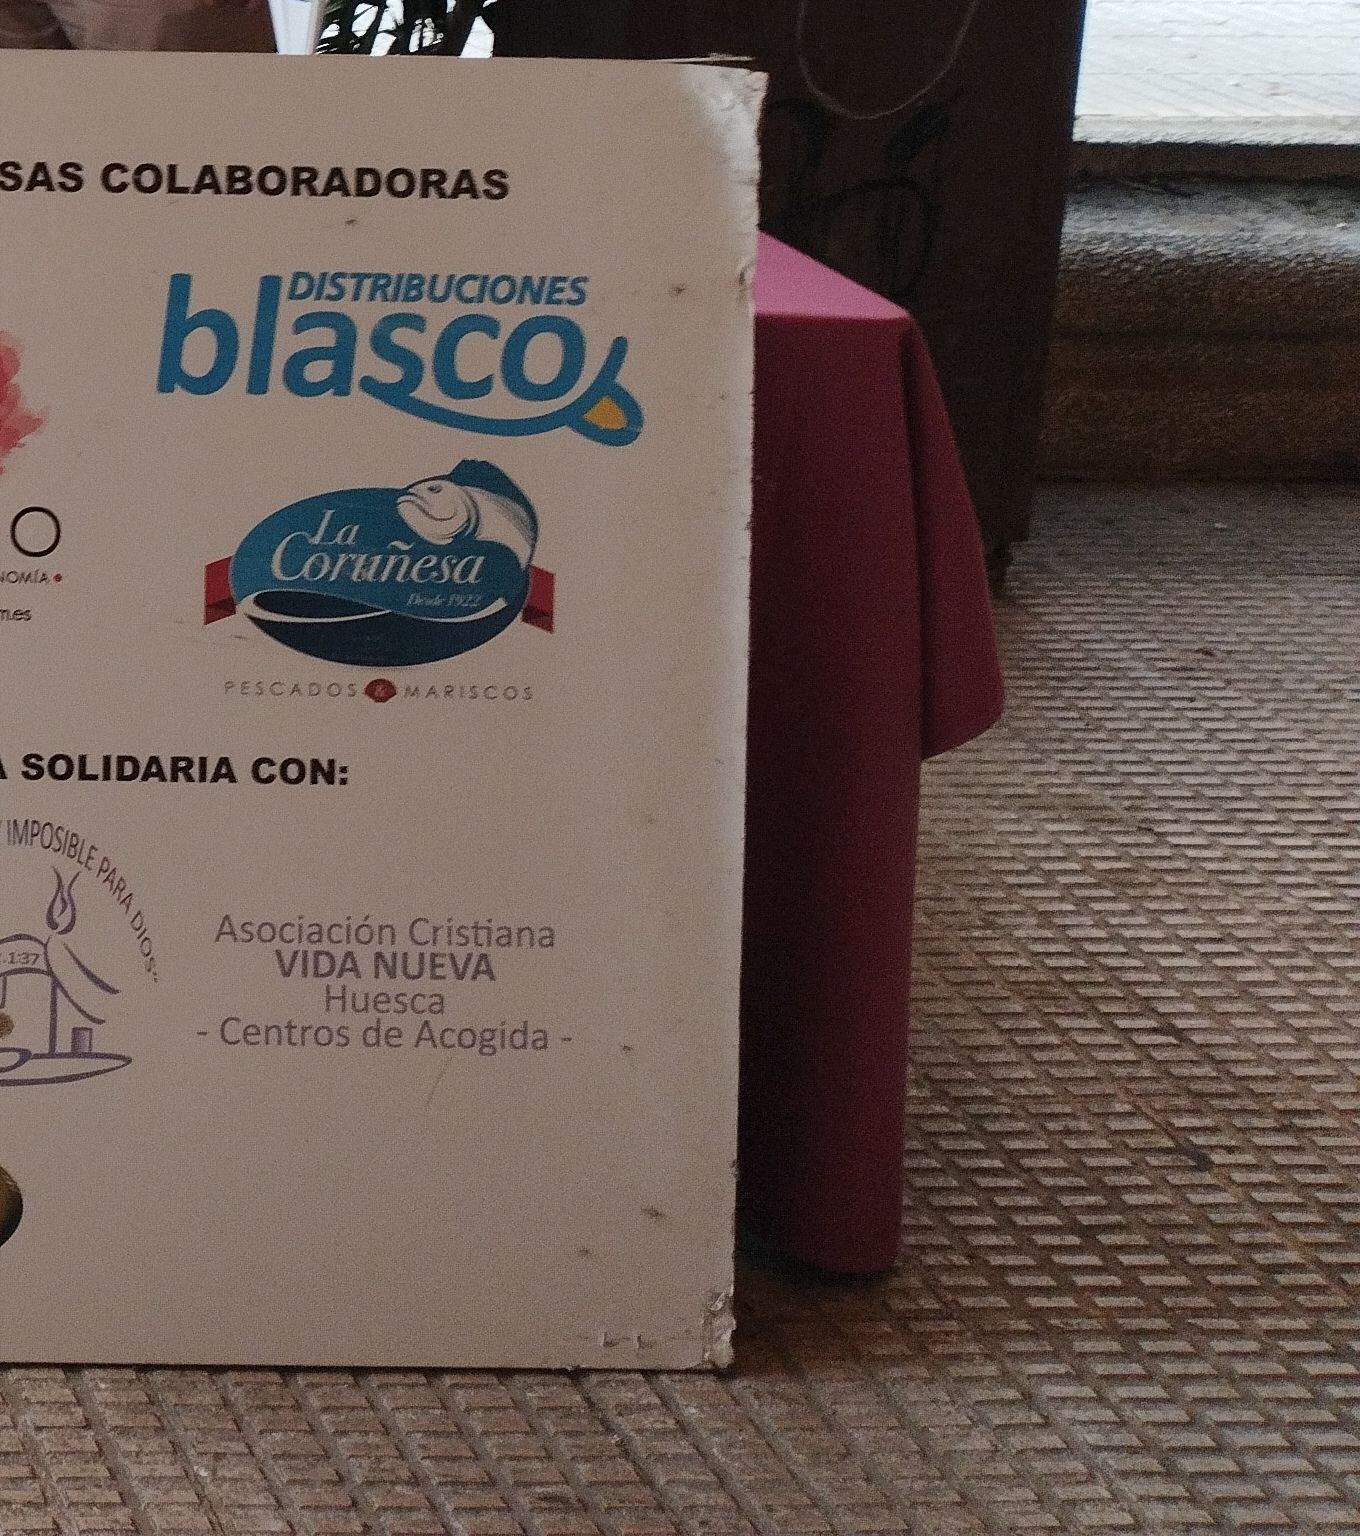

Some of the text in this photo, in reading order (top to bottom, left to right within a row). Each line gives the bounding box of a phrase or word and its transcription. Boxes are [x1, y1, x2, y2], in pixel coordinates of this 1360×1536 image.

[100, 161, 511, 201] COLABORADORAS
[287, 270, 589, 307] DISTRIBUCIONES
[156, 272, 590, 406] blasco
[309, 509, 360, 545] La
[270, 531, 486, 585] Coruñesa
[223, 680, 358, 699] PESCADOS
[403, 682, 536, 701] MARISCOS
[20, 752, 238, 784] SOLIDARIA
[250, 756, 350, 787] CON:
[6, 817, 99, 872] IMPOSIBLE
[95, 855, 134, 915] PARA
[214, 913, 557, 949] Asociación Cristiana
[275, 948, 497, 983] VIDA NUEVA
[324, 983, 446, 1016] Huesca
[219, 1015, 351, 1048] Centros
[361, 1017, 403, 1049] de
[413, 1019, 550, 1058] Acogida
